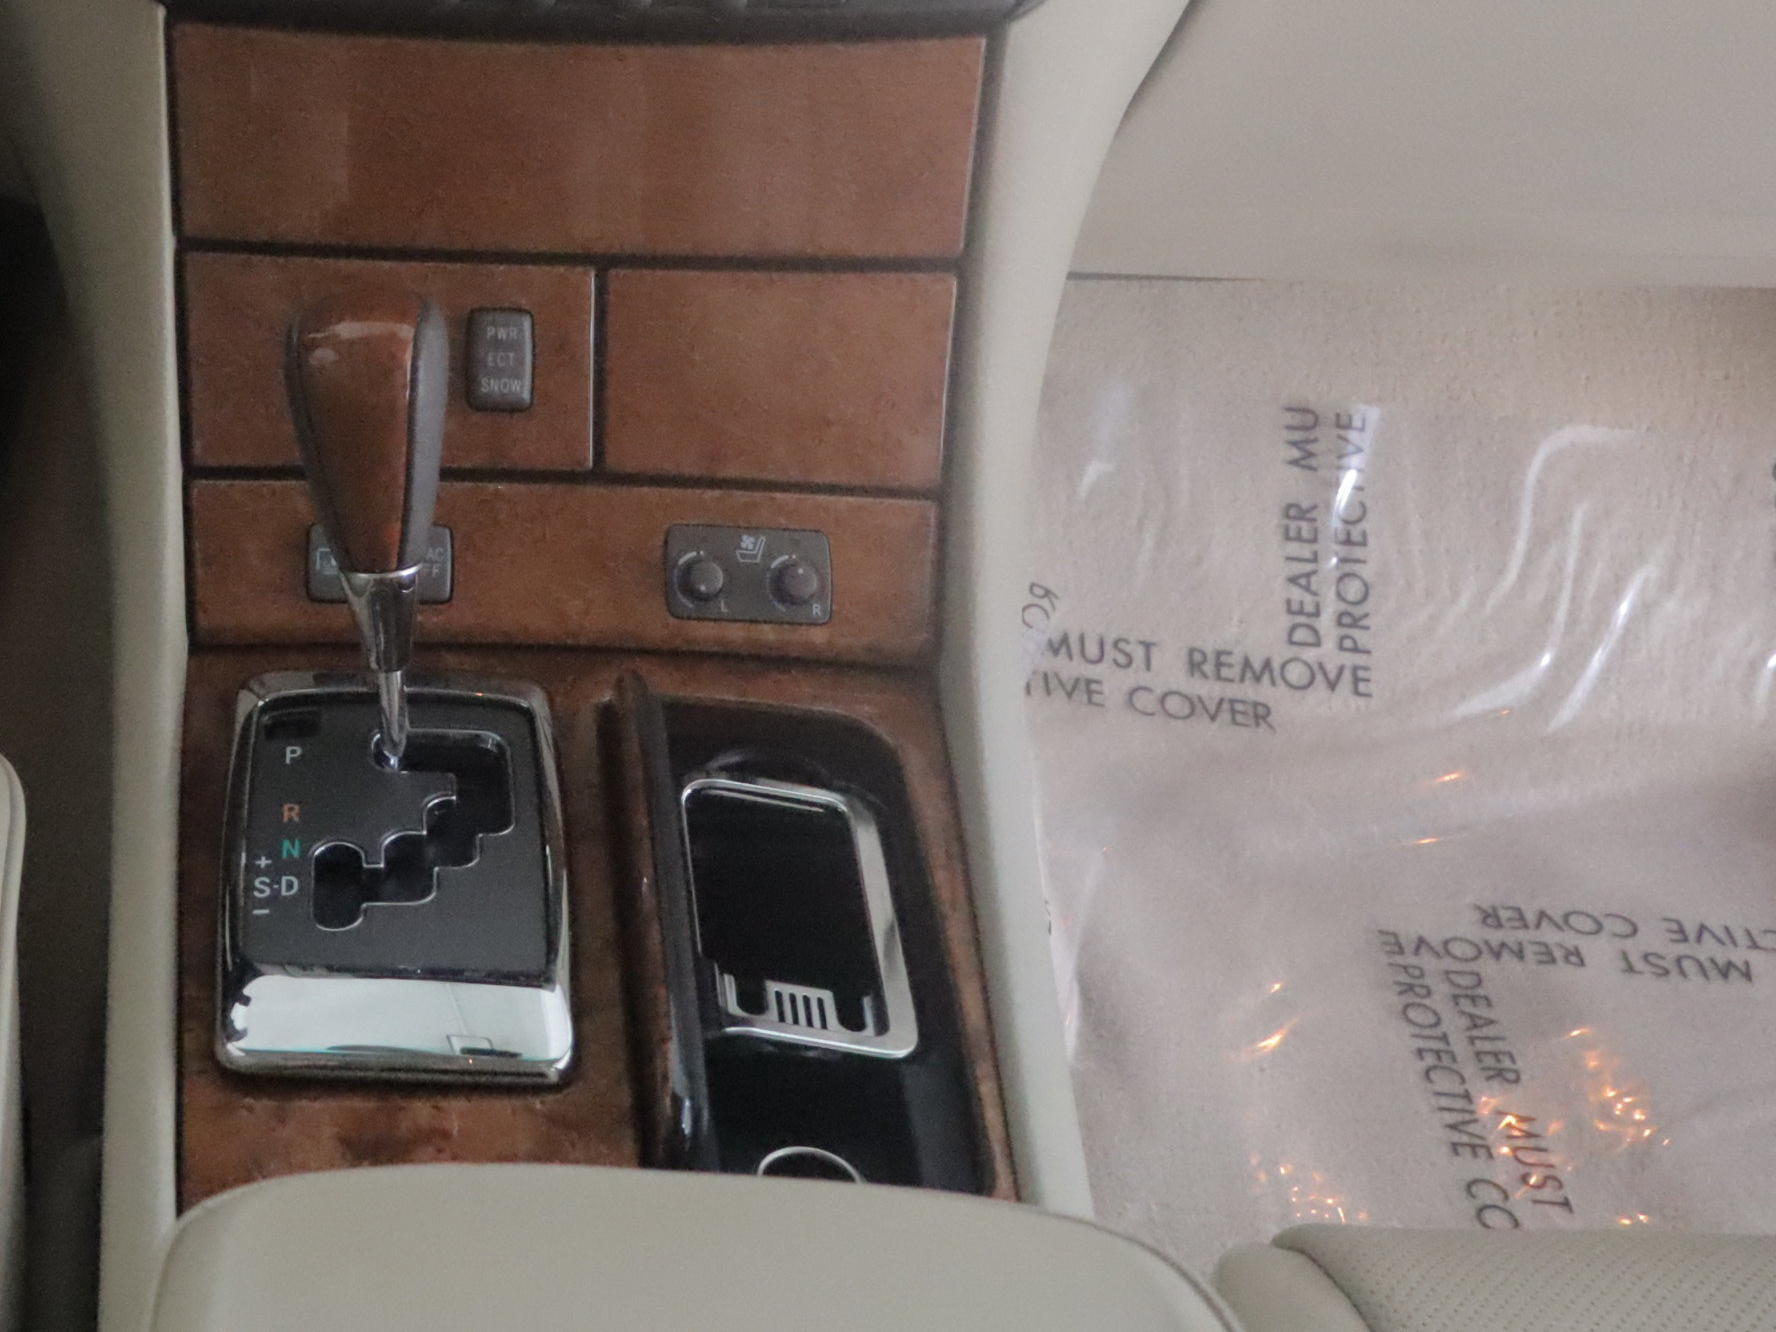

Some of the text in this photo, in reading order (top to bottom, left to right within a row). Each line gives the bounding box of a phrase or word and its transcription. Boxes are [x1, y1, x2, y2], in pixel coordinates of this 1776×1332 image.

[485, 325, 518, 342] PWR
[487, 351, 516, 368] ECT
[479, 376, 523, 394] SNOW
[1282, 402, 1323, 648] DEALER MU
[1044, 631, 1374, 699] MUST REMOVE
[1124, 685, 1276, 732] COVER
[285, 745, 303, 765] P
[283, 803, 301, 823] R
[282, 838, 302, 859] N
[1475, 903, 1638, 937] COVER
[1377, 929, 1754, 983] MUST REMOVE
[1385, 962, 1495, 1161] PROTECTIVE
[1443, 967, 1575, 1216] DEALER MUST
